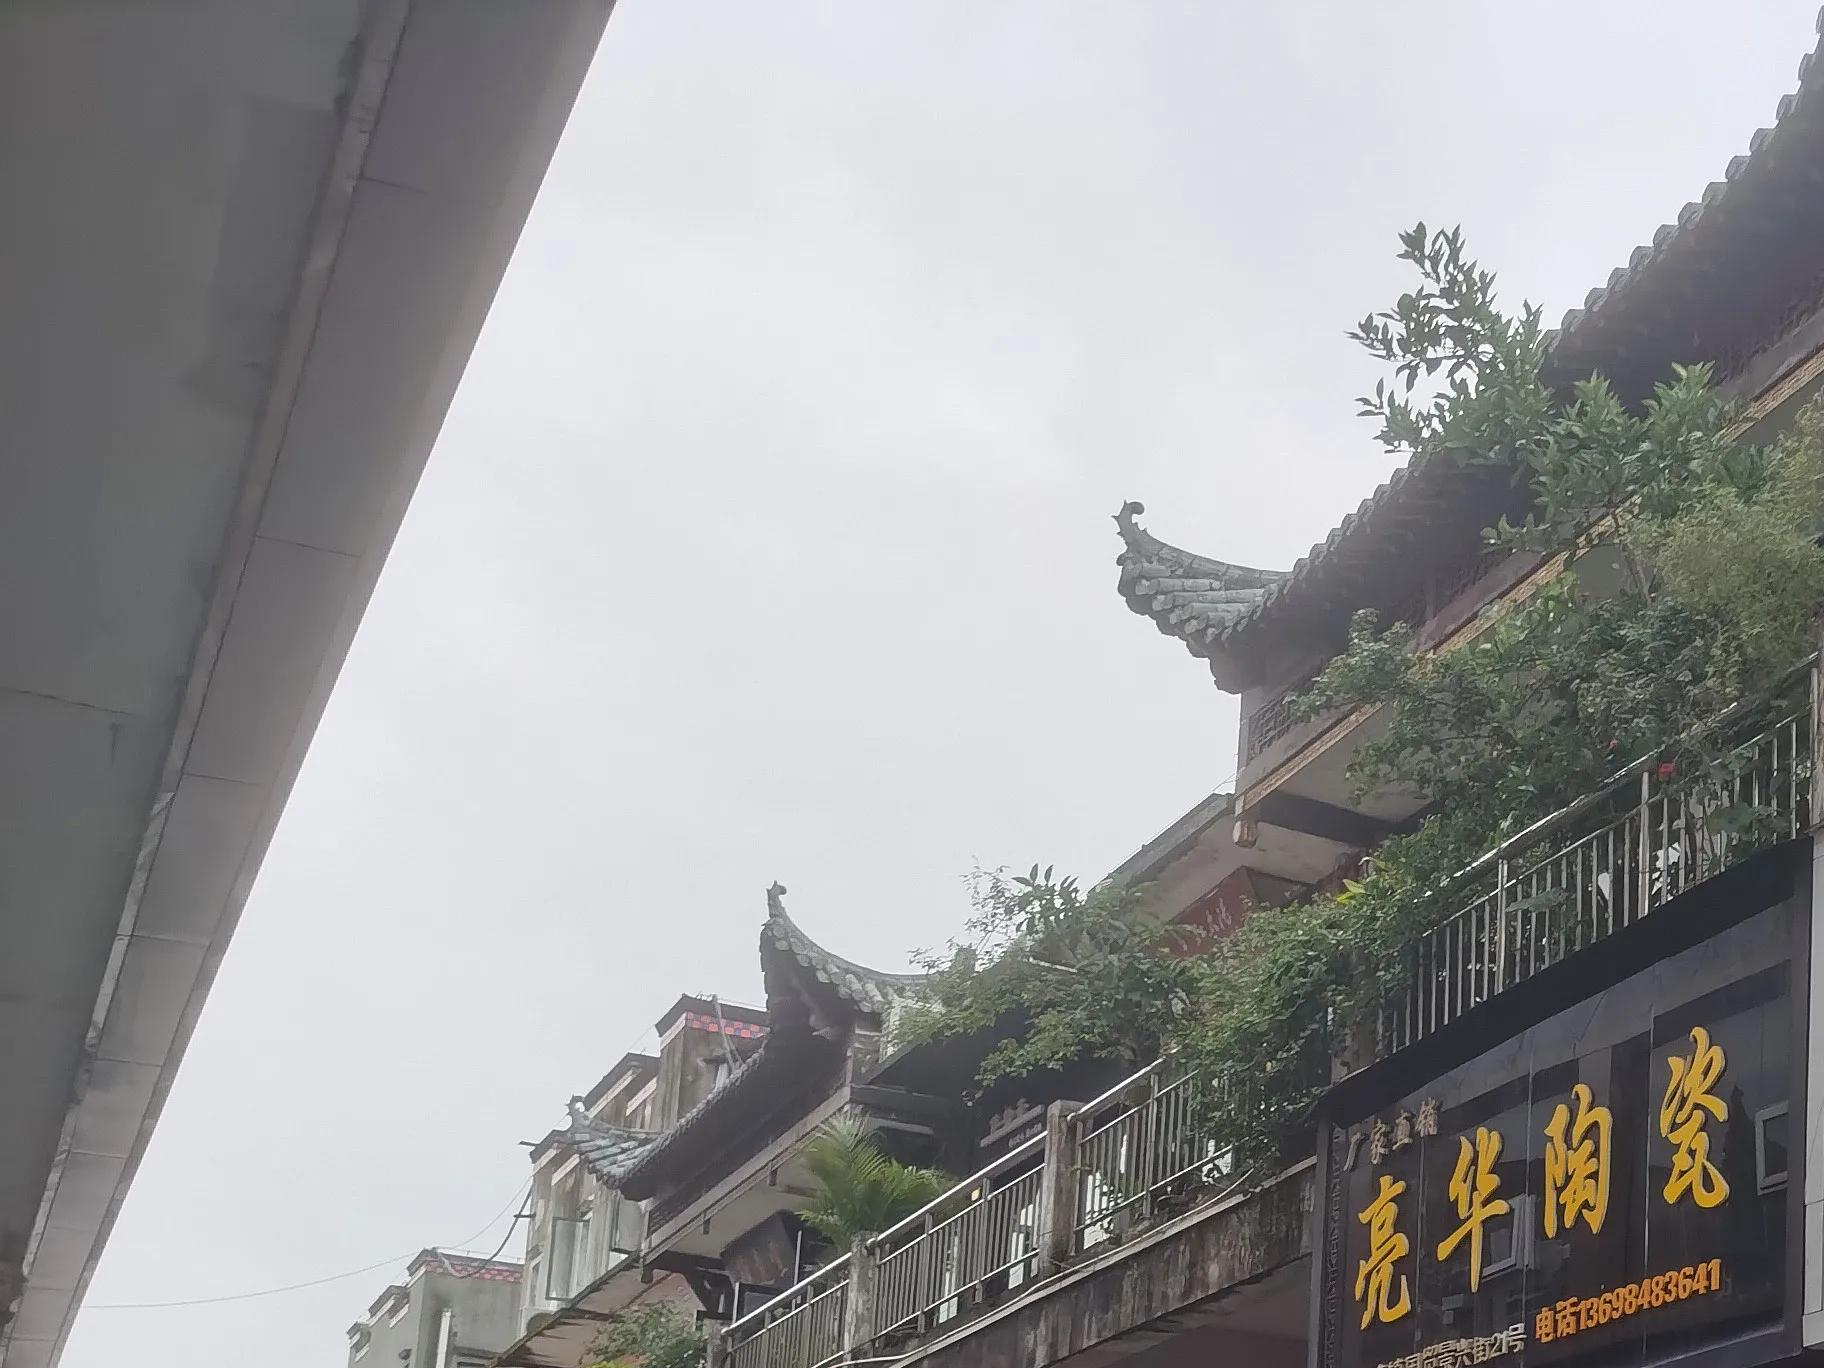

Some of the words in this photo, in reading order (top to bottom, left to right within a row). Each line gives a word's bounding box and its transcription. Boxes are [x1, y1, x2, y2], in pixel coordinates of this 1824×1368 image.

[1343, 1097, 1439, 1172] 厂家直销
[1354, 1026, 1730, 1331] 亮华陶瓷
[1535, 1258, 1722, 1344] 电话13698483641
